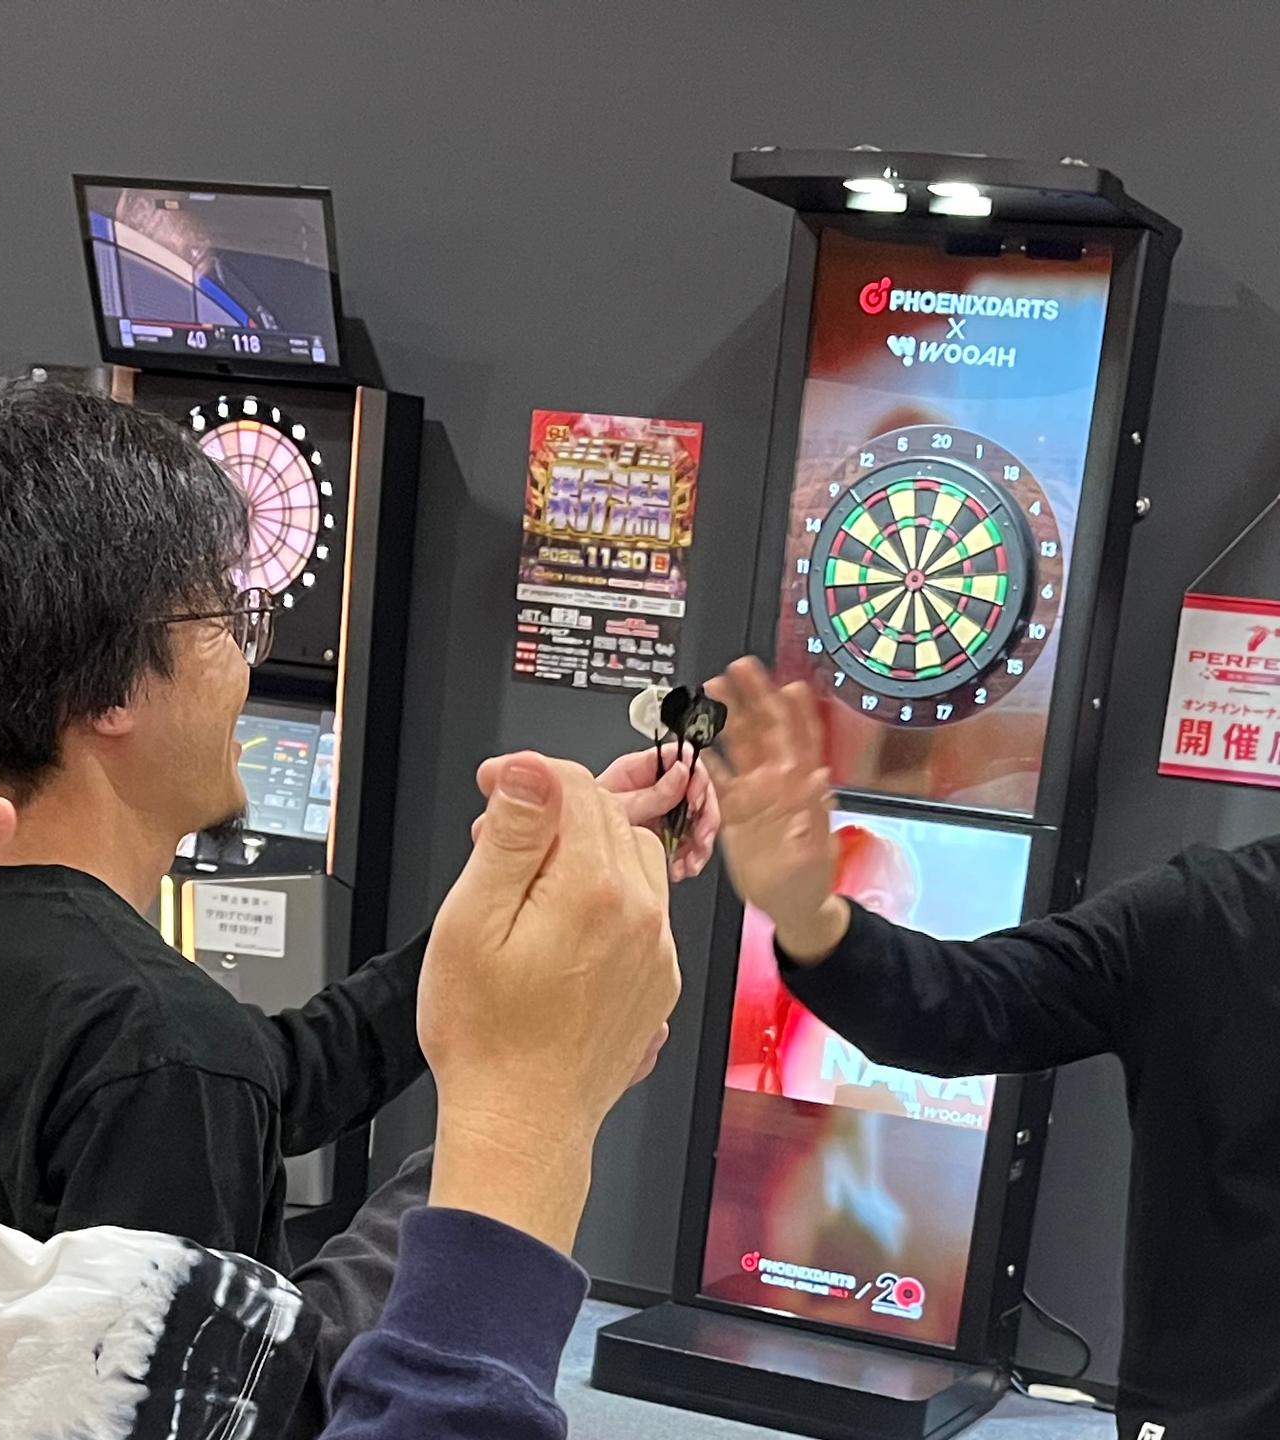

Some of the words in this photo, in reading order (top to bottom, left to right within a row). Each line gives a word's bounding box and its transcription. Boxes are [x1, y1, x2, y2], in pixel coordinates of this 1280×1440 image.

[889, 290, 1059, 321] PHOENIXDARTS
[186, 331, 207, 349] 40
[232, 334, 261, 353] 118
[919, 341, 1016, 368] WOOAH
[897, 437, 908, 452] 5
[931, 433, 952, 449] 20
[976, 444, 983, 459] 1
[860, 453, 874, 467] 12
[1004, 465, 1019, 481] 18
[829, 483, 840, 497] 9
[1029, 501, 1040, 516] 4
[806, 518, 821, 533] 14
[1041, 541, 1057, 557] 13
[587, 546, 647, 572] 11.30
[797, 559, 809, 573] 11
[1041, 583, 1053, 599] 6
[797, 599, 808, 614] 8
[1028, 623, 1045, 639] 10
[807, 637, 823, 653] 16
[1007, 659, 1023, 675] 15
[834, 671, 845, 687] 7
[861, 695, 878, 710] 19
[974, 688, 987, 704] 2
[900, 706, 912, 721] 3
[936, 704, 953, 720] 17
